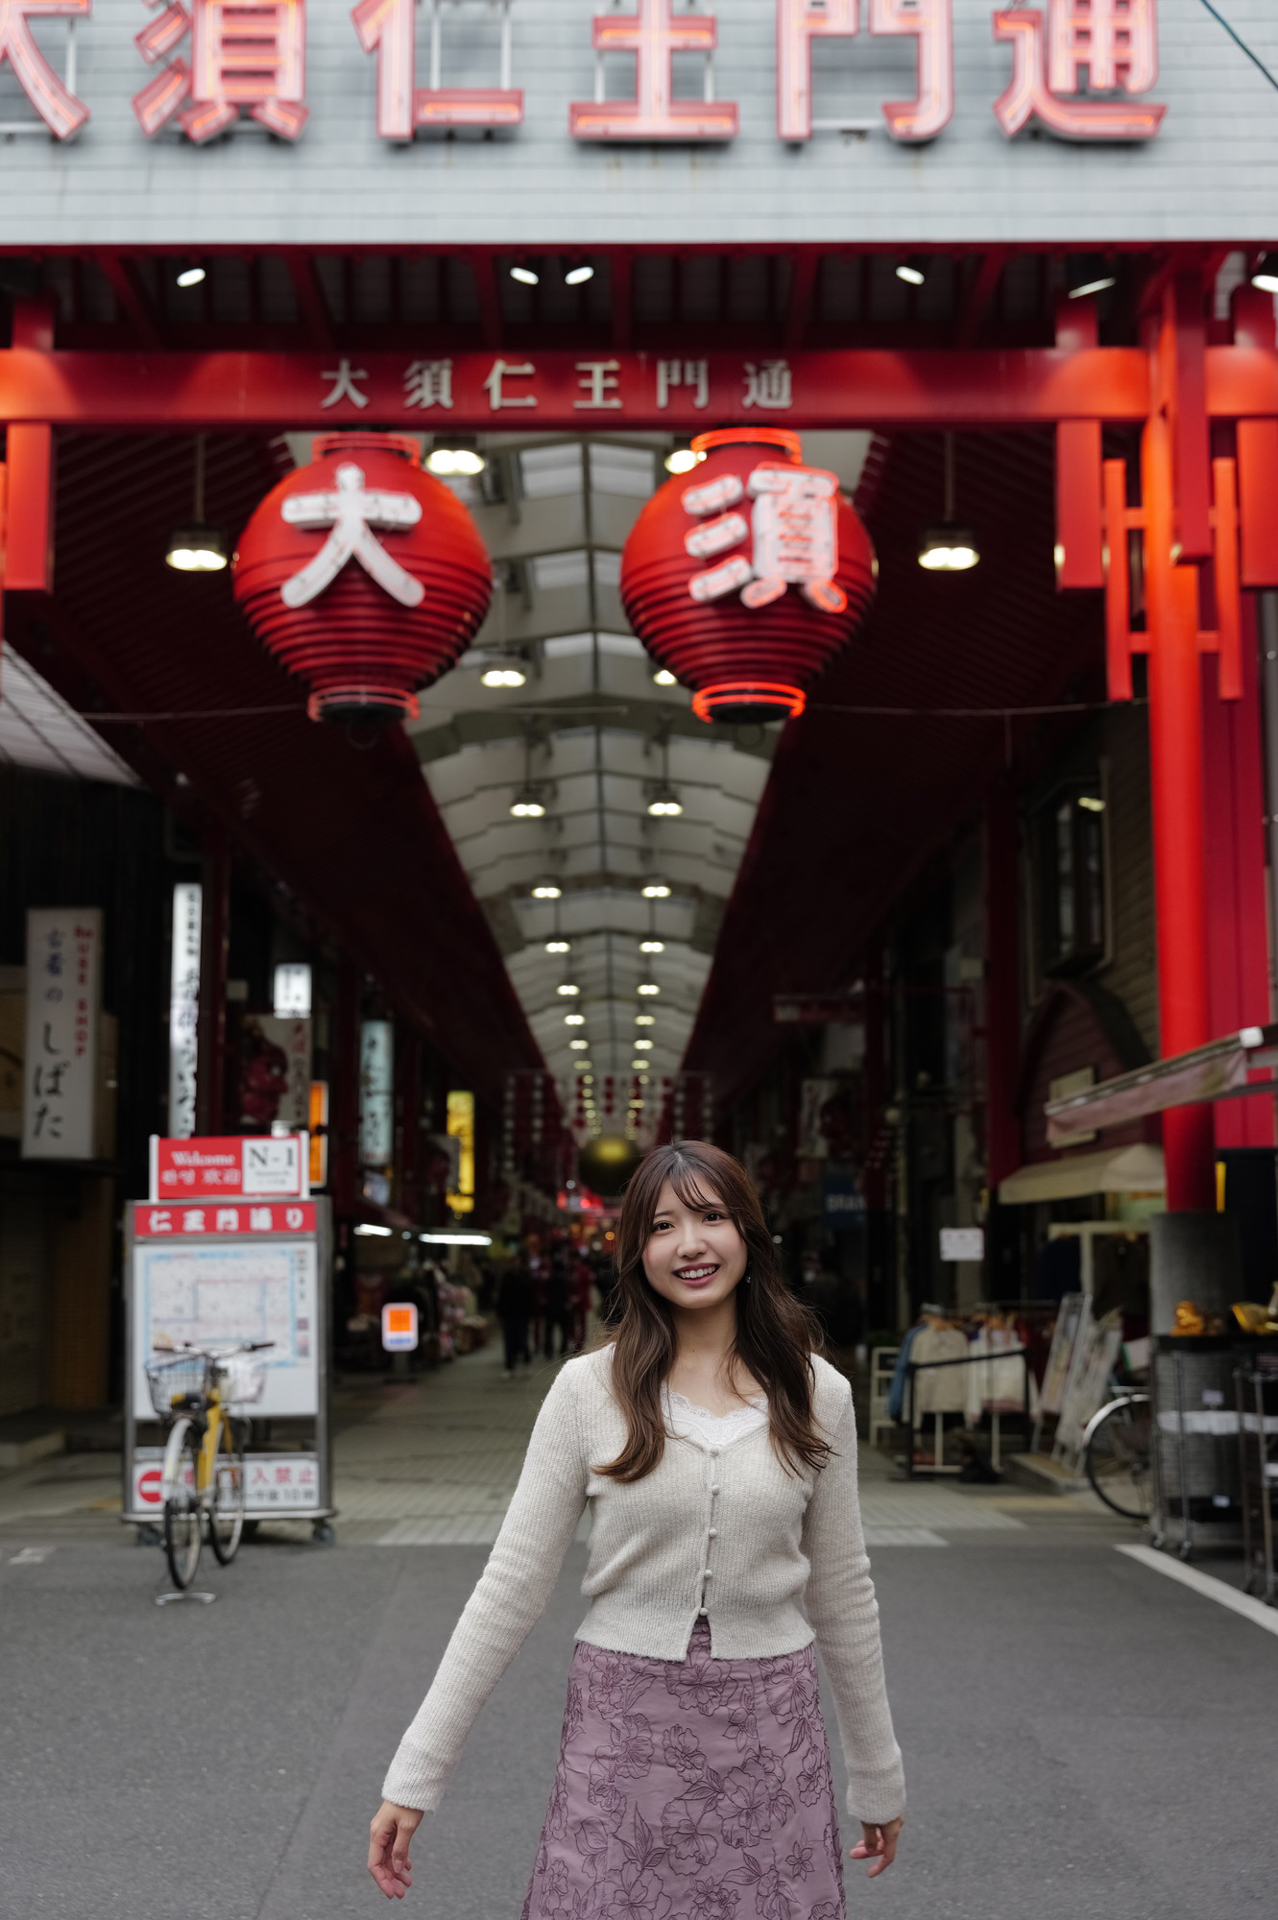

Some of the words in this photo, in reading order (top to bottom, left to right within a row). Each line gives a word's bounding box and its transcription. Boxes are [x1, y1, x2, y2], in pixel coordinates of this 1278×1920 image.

[320, 358, 794, 411] 大須仁王門通
[281, 462, 426, 608] 大
[681, 461, 849, 614] 須
[171, 1151, 235, 1166] Welcome
[249, 1146, 295, 1167] N-1
[149, 1207, 304, 1233] 仁王門通り
